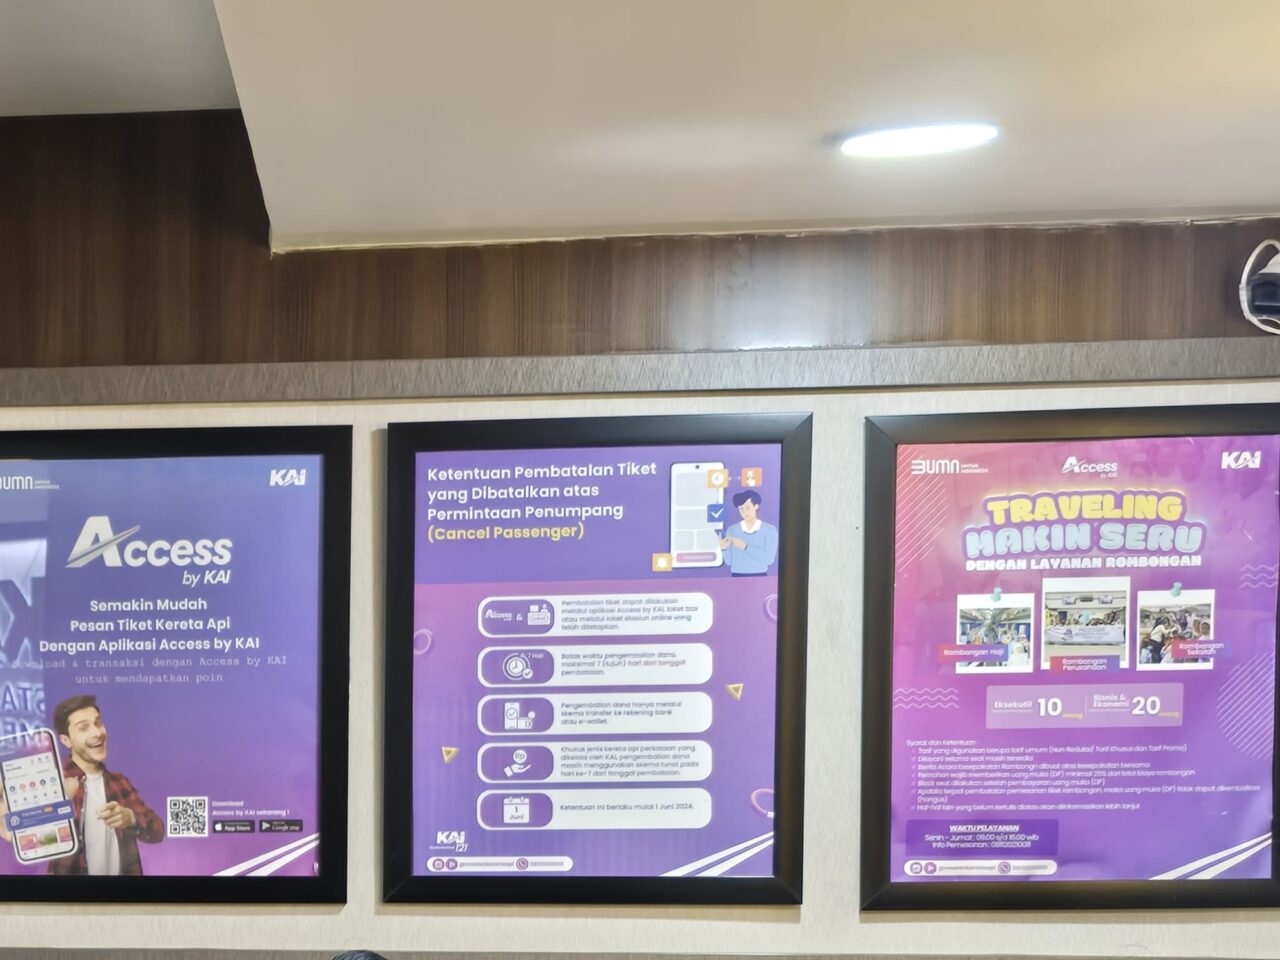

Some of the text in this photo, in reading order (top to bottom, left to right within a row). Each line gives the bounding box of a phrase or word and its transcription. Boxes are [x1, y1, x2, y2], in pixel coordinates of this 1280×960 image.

[1062, 457, 1118, 474] Access
[1221, 451, 1262, 470] KAI
[270, 469, 306, 487] KAI
[427, 462, 656, 481] Ketentuan Pembatalan Tiket
[427, 485, 599, 504] yang Dibatalkan atas
[428, 505, 623, 521] Permintaan Penumpang
[987, 494, 1183, 524] TRAVELING
[65, 516, 233, 568] Access
[427, 523, 585, 543] (Cancel Passenger)
[966, 524, 1203, 557] MAKIN SERU
[966, 555, 1201, 570] DENGAN LAYANAN ROMBONGAN
[183, 570, 231, 588] by KAI
[90, 599, 207, 612] Semakin Mudah
[71, 617, 230, 633] Pesan Tiket Kereta Api
[40, 637, 260, 656] Dengan Aplikasi Access by KAI
[85, 658, 145, 668] transaksi
[152, 657, 192, 670] dengan
[199, 657, 239, 666] Access
[247, 656, 260, 669] by
[267, 656, 287, 665] KAI
[75, 673, 223, 685] untuk mendapatkan poin
[1038, 698, 1062, 716] 10
[1132, 697, 1161, 715] 20
[437, 831, 466, 844] KAI
